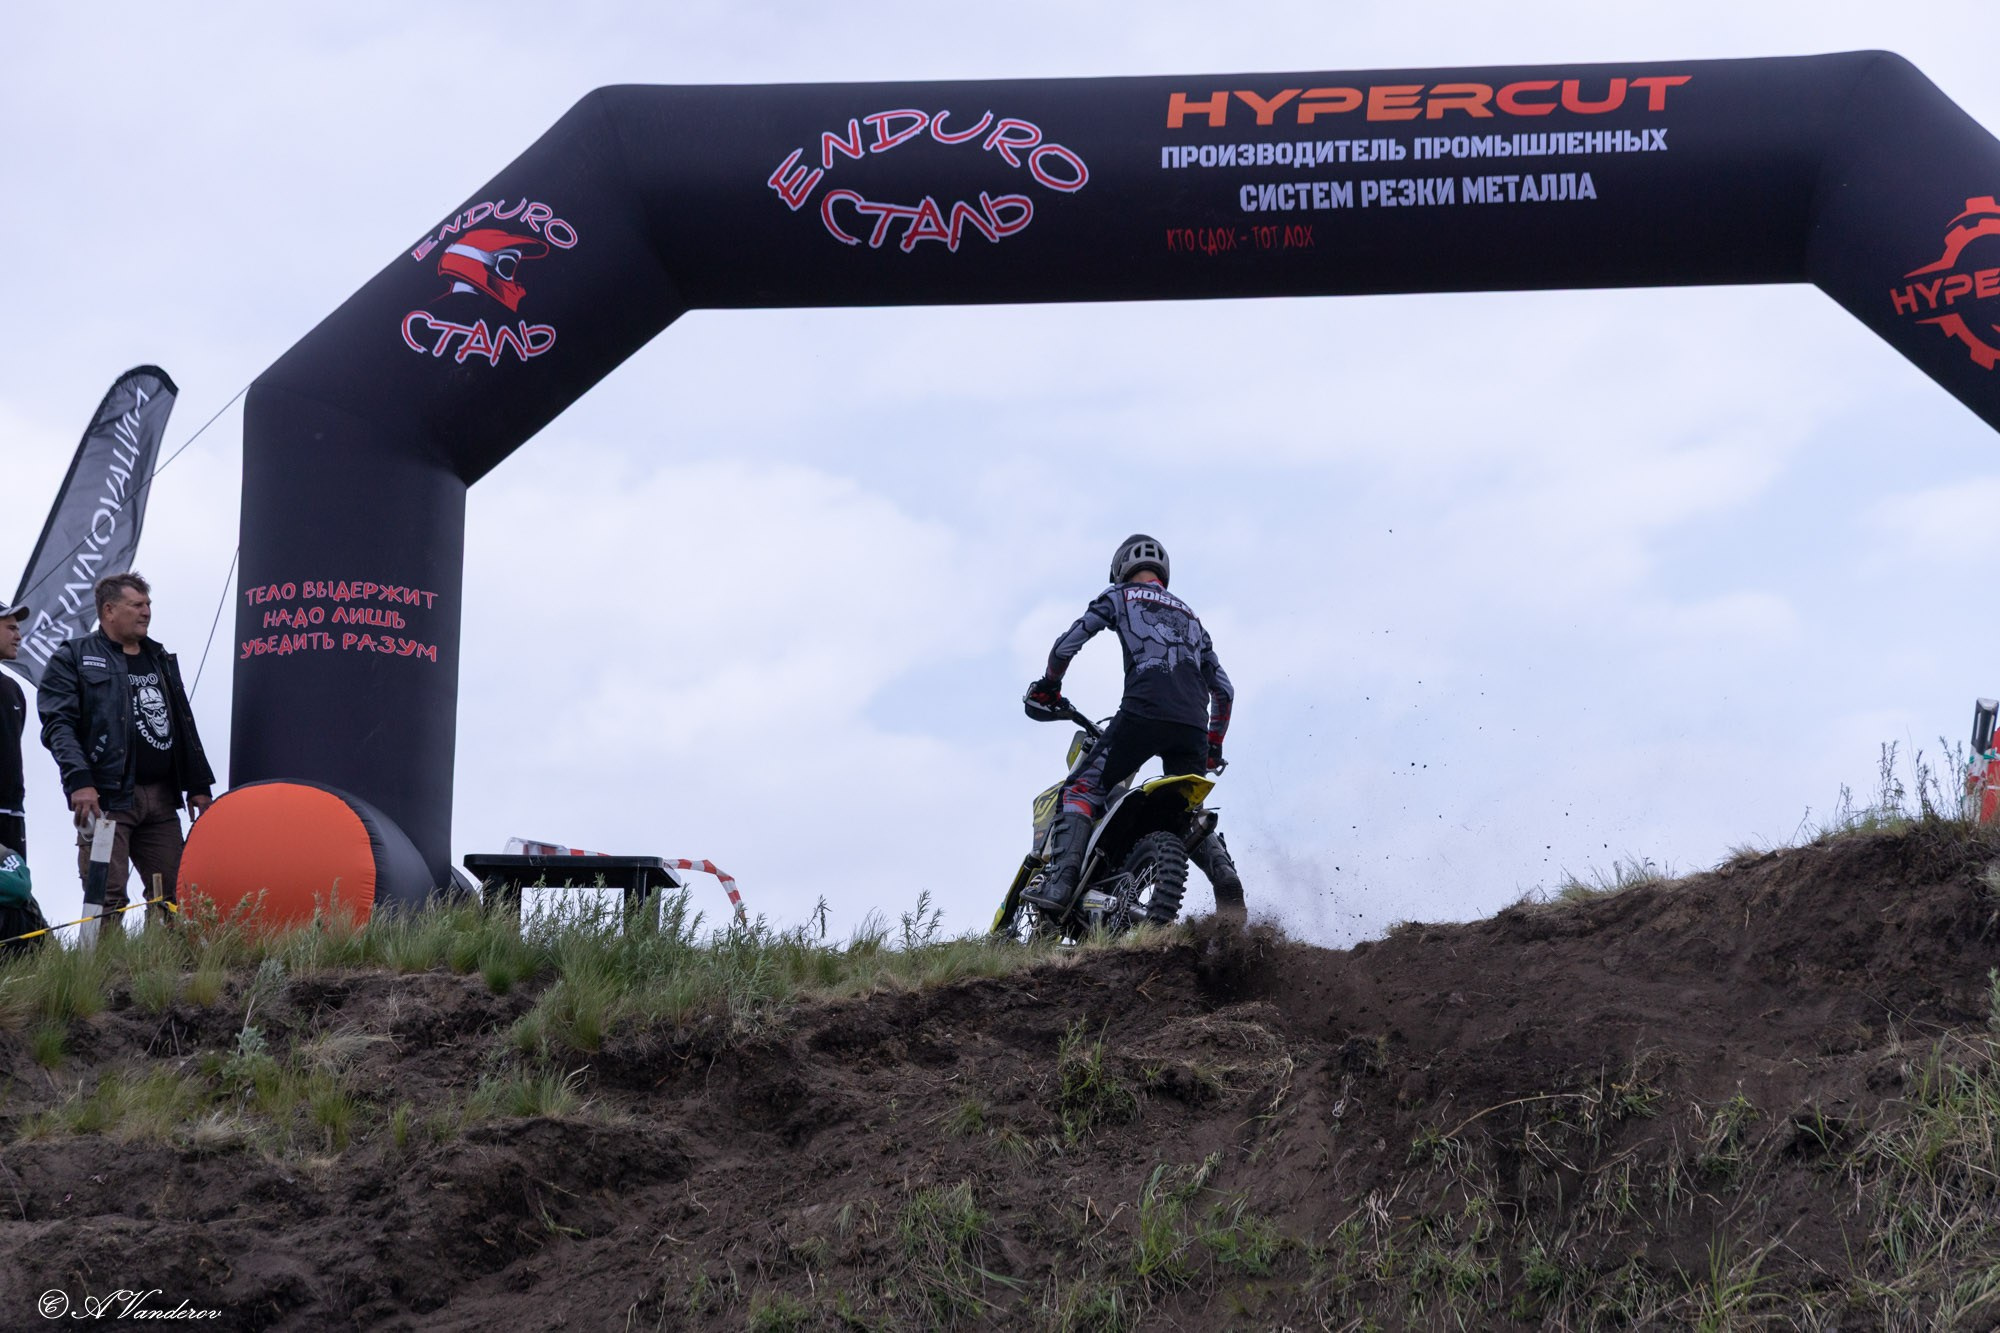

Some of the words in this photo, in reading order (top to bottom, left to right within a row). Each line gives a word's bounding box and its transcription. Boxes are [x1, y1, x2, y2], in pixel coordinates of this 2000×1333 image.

[1167, 75, 1692, 128] HYPERCUT
[767, 109, 1089, 211] ENDURO
[1161, 138, 1406, 168] ПРОИЗВОДИТЕЛЬ
[1414, 128, 1668, 160] ПРОМЫШЛЕННЫХ
[1240, 180, 1353, 212] СИСТЕМ
[1361, 177, 1454, 208] РЕЗКИ
[1462, 172, 1597, 205] МЕТАЛЛА
[411, 197, 578, 261] ENDURO
[1166, 228, 1195, 252] КТО
[1198, 227, 1237, 256] СДОХ
[1251, 225, 1279, 249] ТОТ
[1283, 224, 1315, 249] ЛОХ
[245, 582, 296, 606] ТЕЛО
[302, 581, 438, 609] ВЫДЕРЖИТ
[263, 607, 324, 628] НАДО
[332, 606, 406, 629] ЛИШЬ
[240, 632, 335, 659] УБЕДИТЬ
[342, 632, 437, 662] РАЗУМ
